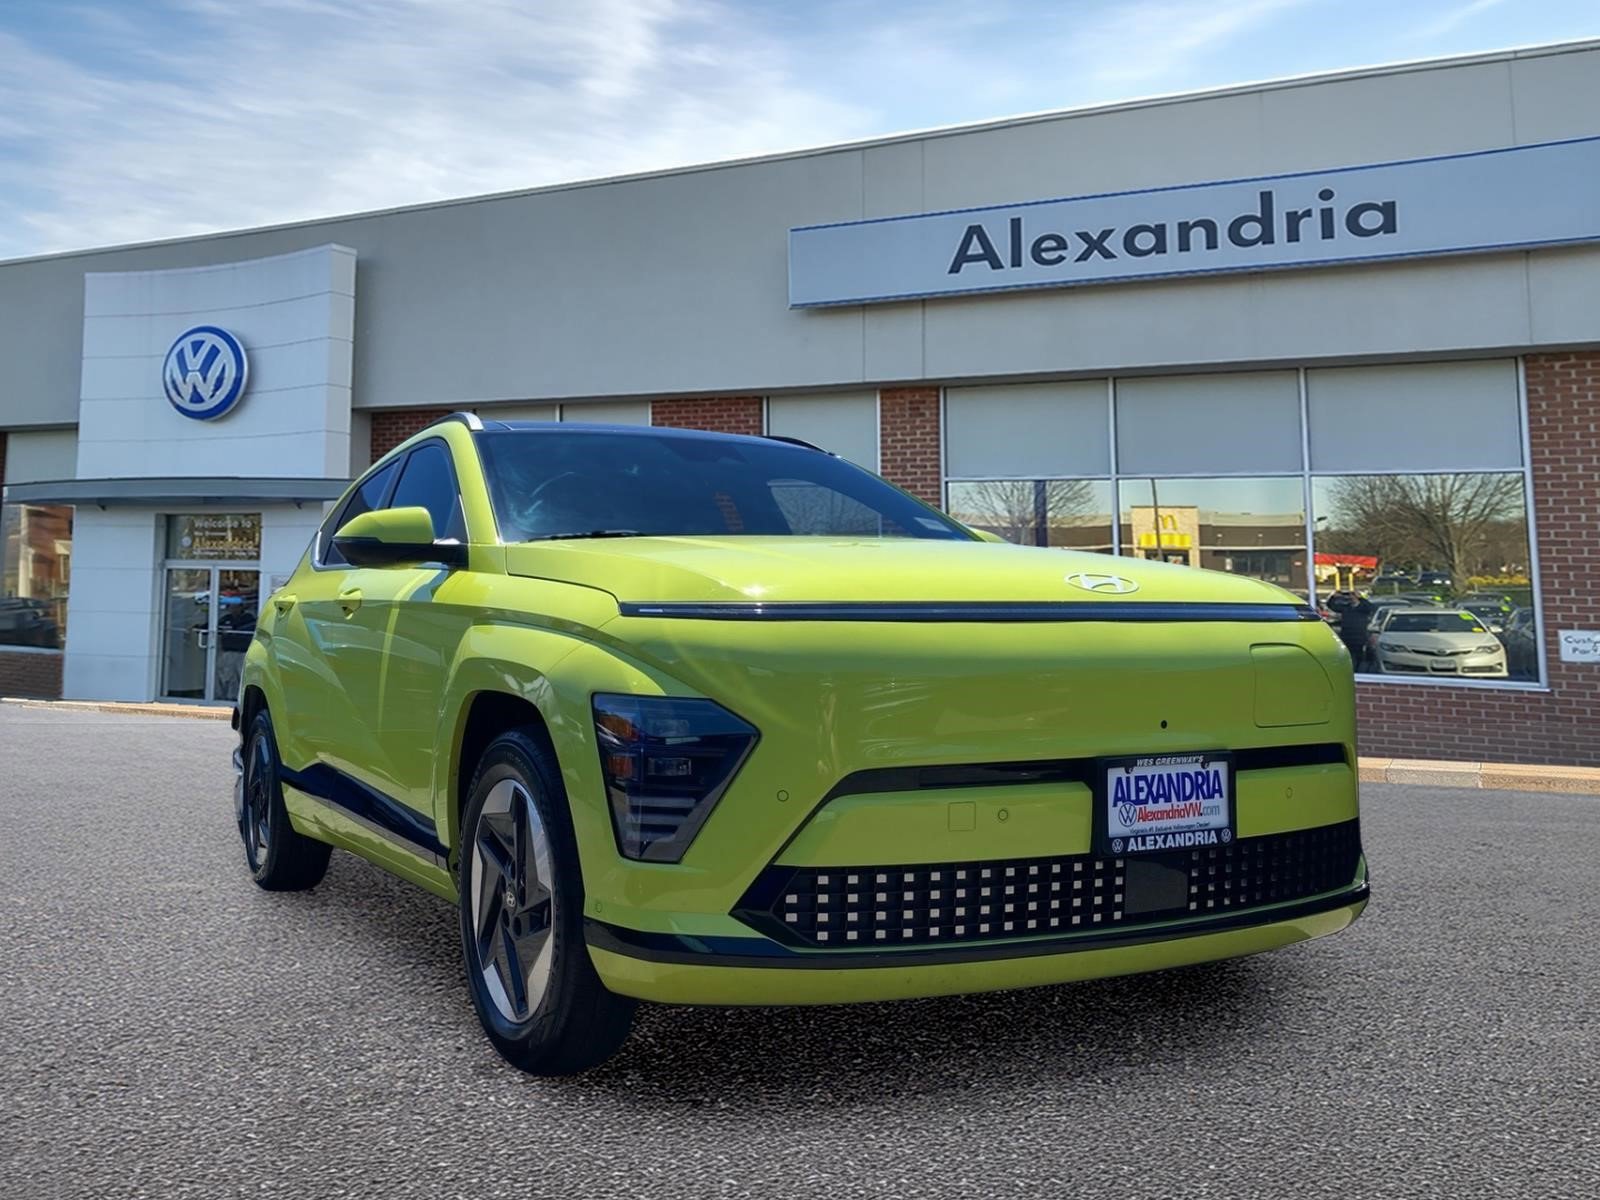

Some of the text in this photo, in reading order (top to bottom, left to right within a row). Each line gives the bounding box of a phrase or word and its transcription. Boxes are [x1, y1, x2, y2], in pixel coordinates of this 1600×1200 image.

[948, 188, 1398, 274] Alexandria
[1136, 755, 1204, 767] WES GREENWAY'S
[1112, 769, 1223, 807] ALEXANDRIA
[1127, 830, 1218, 852] ALEXANDRIA
